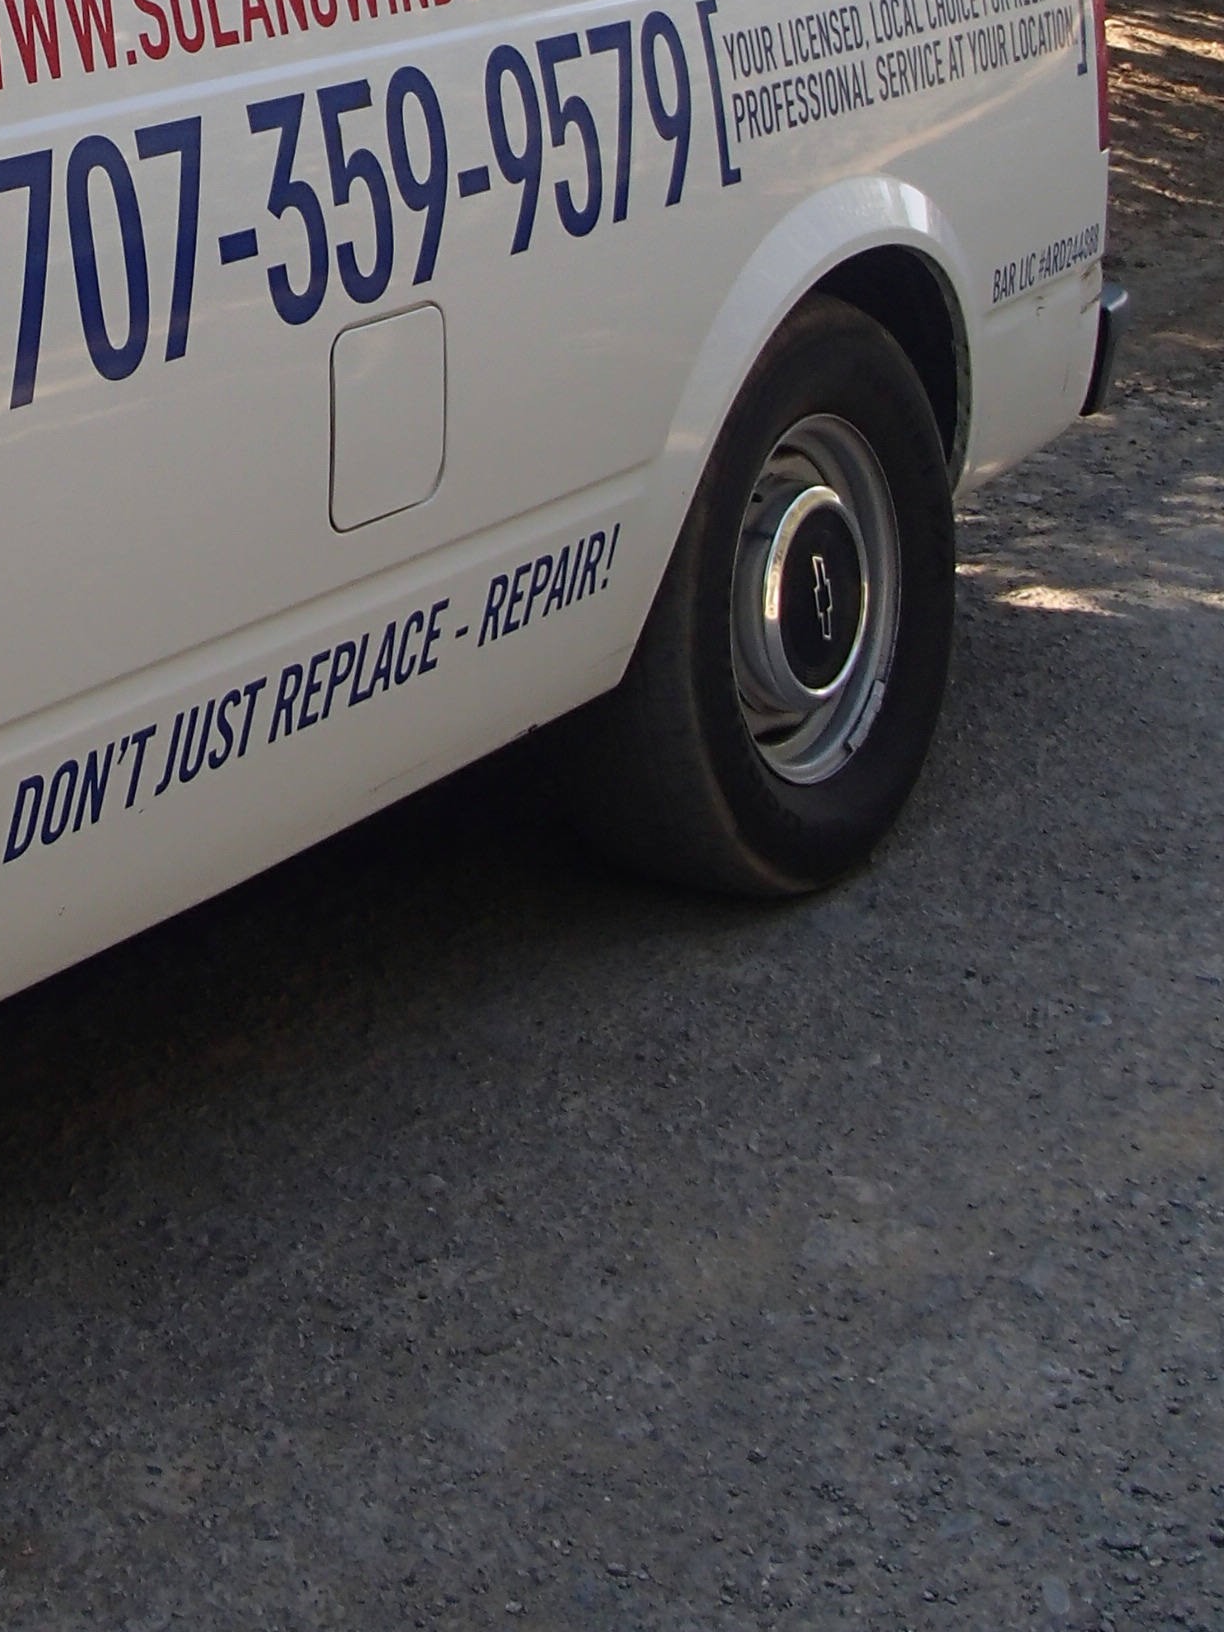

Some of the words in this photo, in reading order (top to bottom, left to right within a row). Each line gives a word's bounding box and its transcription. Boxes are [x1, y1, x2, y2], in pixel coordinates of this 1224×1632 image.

[722, 25, 778, 81] YOUR
[775, 4, 871, 68] LICENSED,
[731, 60, 875, 143] PROFESSIONAL
[875, 40, 946, 101] SERVICE
[948, 33, 966, 82] AT
[967, 23, 1009, 75] YOUR
[992, 261, 1016, 303] BAR
[1019, 252, 1036, 291] LIC
[2, 723, 157, 863] DON'T
[154, 676, 267, 797] JUST
[267, 597, 450, 744] REPLACE
[477, 522, 621, 648] REPAIR!
